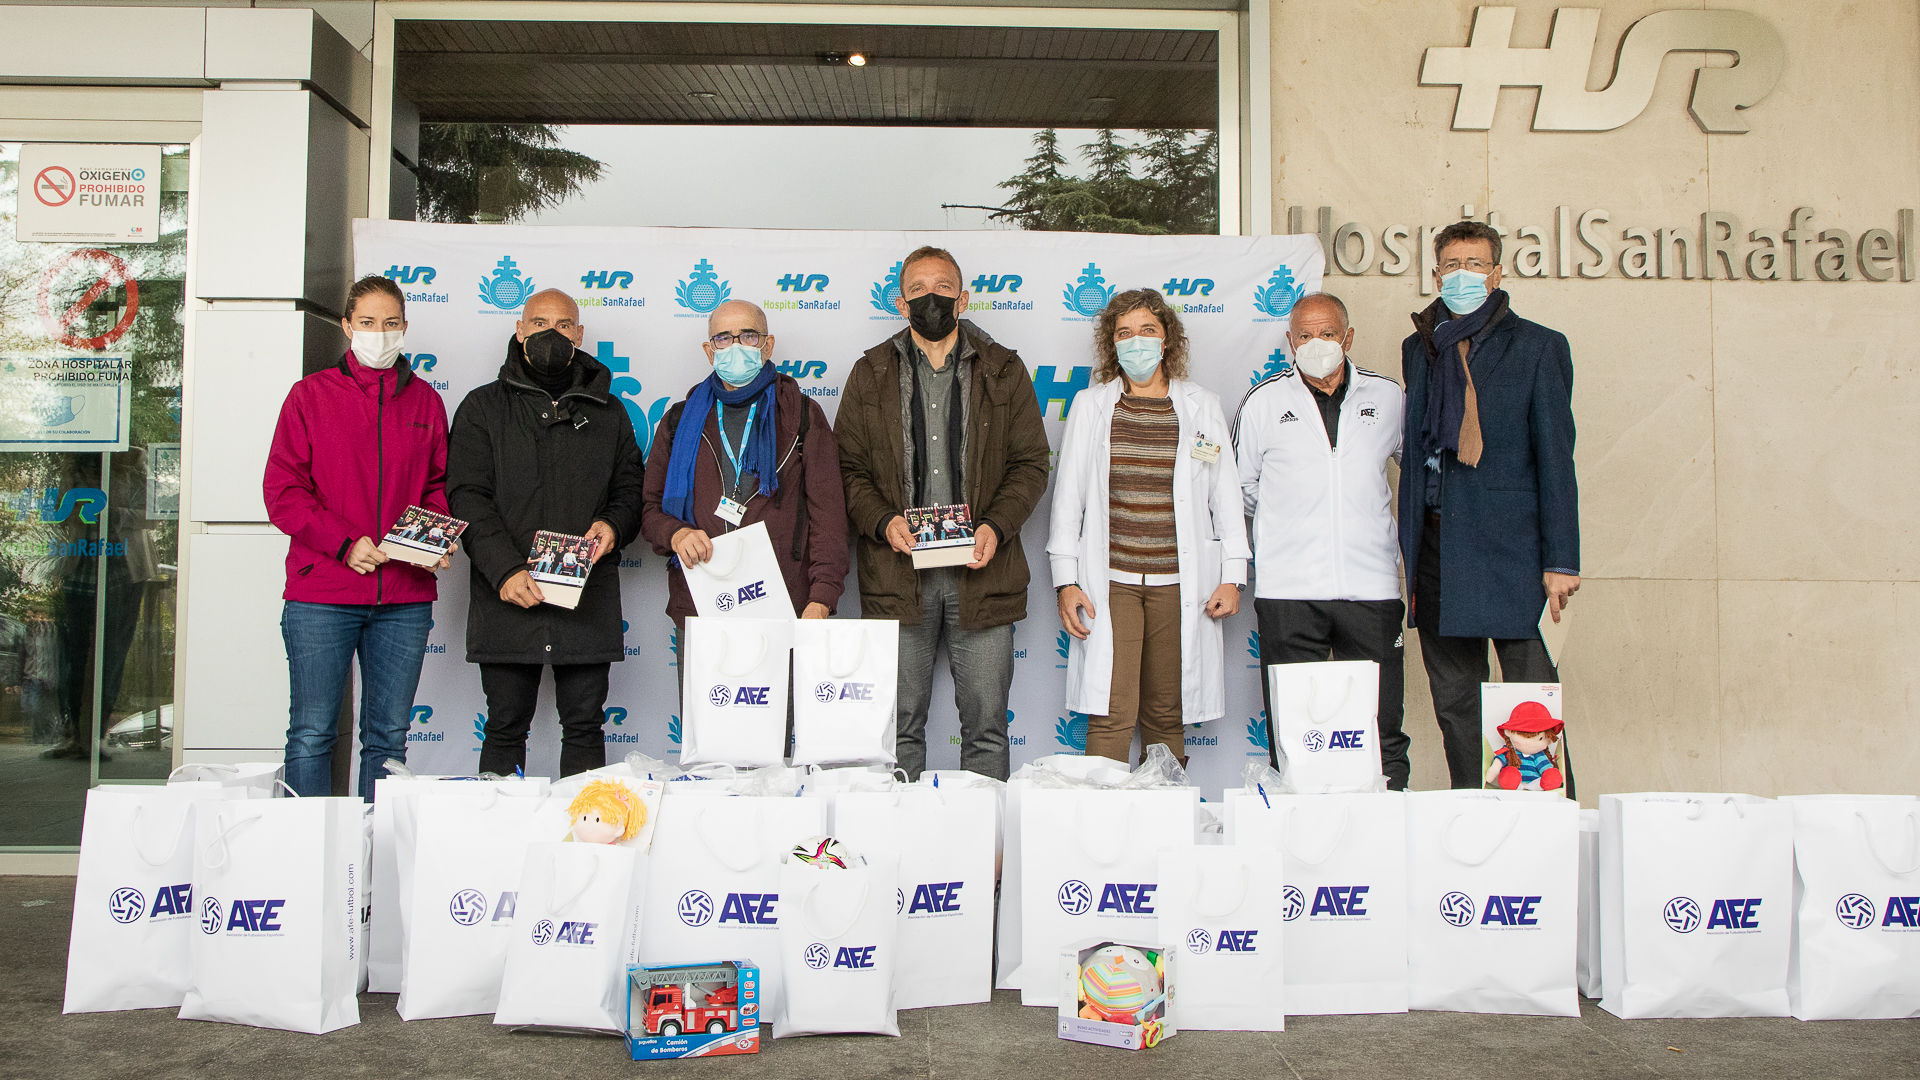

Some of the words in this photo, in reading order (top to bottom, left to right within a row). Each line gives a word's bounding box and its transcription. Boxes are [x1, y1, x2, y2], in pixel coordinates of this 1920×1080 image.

[79, 184, 146, 194] PROHIBIDO
[79, 194, 145, 207] FUMAR
[763, 299, 841, 311] HospitalSanRafael
[28, 360, 59, 369] ZONA
[98, 372, 137, 381] FUMAR
[738, 579, 767, 605] AFE
[733, 686, 771, 705] AFE
[838, 682, 875, 701] AFE
[1328, 729, 1365, 749] AFE
[149, 883, 193, 918] AF
[717, 892, 779, 925] AFE
[907, 881, 965, 915] AFE
[1097, 883, 1158, 914] AFE
[1310, 886, 1370, 917] AFE
[226, 899, 287, 932] AFE
[346, 863, 355, 961] www.afe-futbol.com
[1480, 895, 1543, 926] AFE
[1706, 898, 1763, 930] AFE
[1881, 896, 1920, 927] AF
[555, 921, 600, 945] AFE
[1215, 930, 1259, 952] AFE
[833, 945, 877, 969] AFE
[660, 1046, 688, 1054] Bomberos
